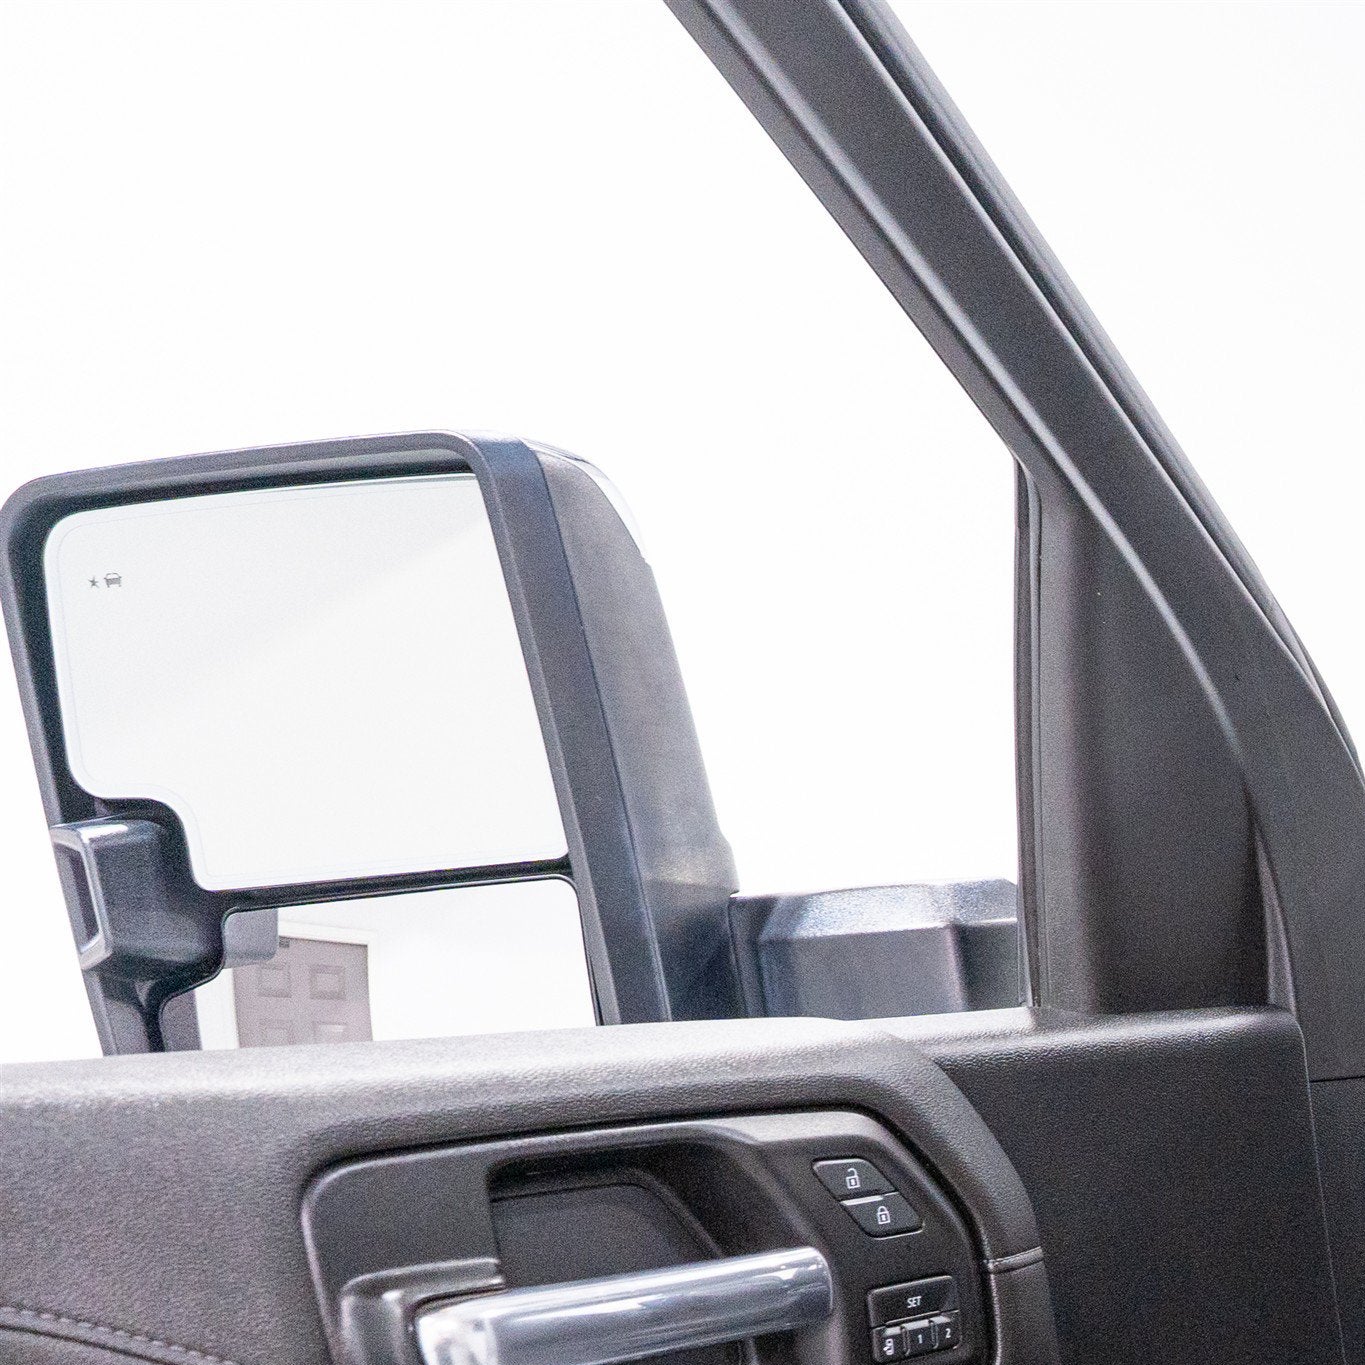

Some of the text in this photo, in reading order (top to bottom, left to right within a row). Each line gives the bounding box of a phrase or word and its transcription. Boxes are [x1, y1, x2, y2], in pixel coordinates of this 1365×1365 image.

[907, 1295, 922, 1308] SET
[917, 1334, 923, 1344] 1
[945, 1328, 952, 1339] 2
